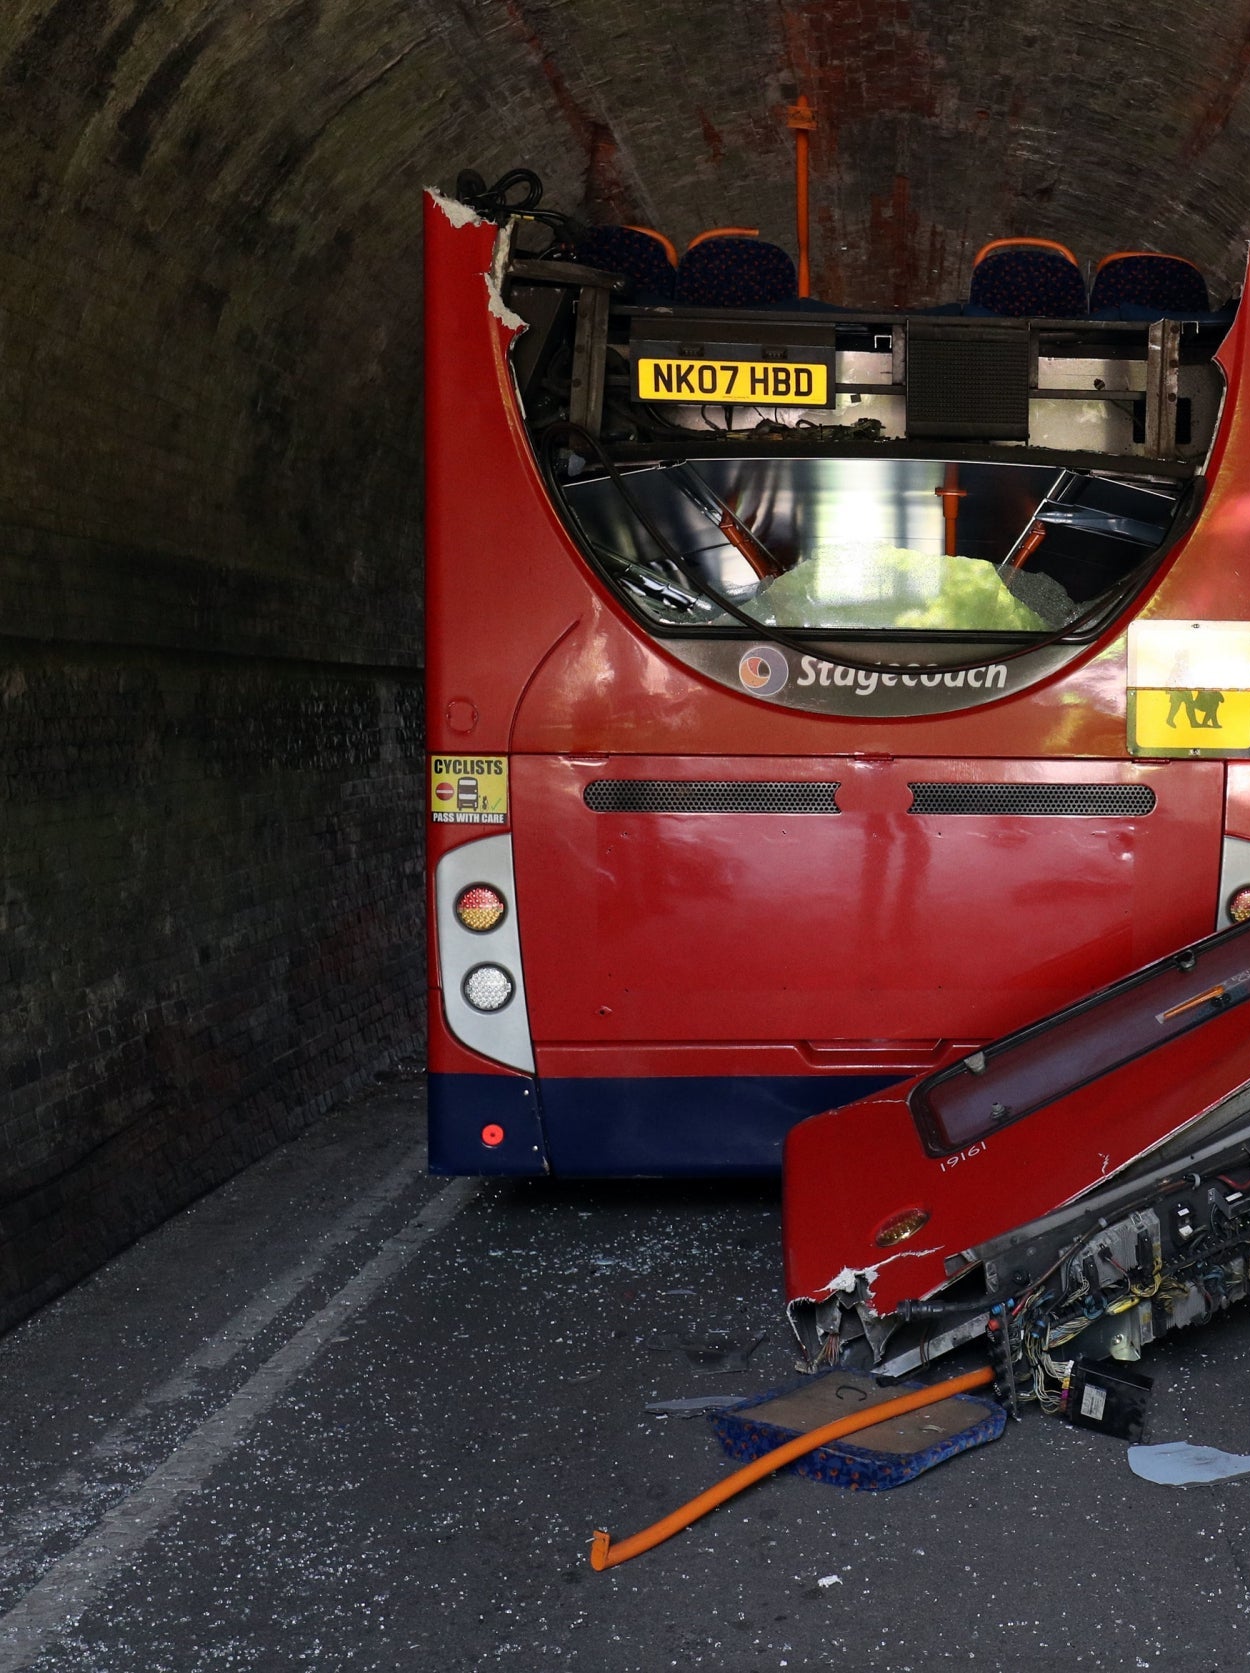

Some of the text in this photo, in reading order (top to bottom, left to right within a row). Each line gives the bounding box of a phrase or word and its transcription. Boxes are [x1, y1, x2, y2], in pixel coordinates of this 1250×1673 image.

[653, 363, 813, 397] NK07 HBD
[434, 759, 503, 775] CYCLISTS
[433, 812, 504, 824] PASS WITH CARE
[940, 1141, 987, 1172] 19161
